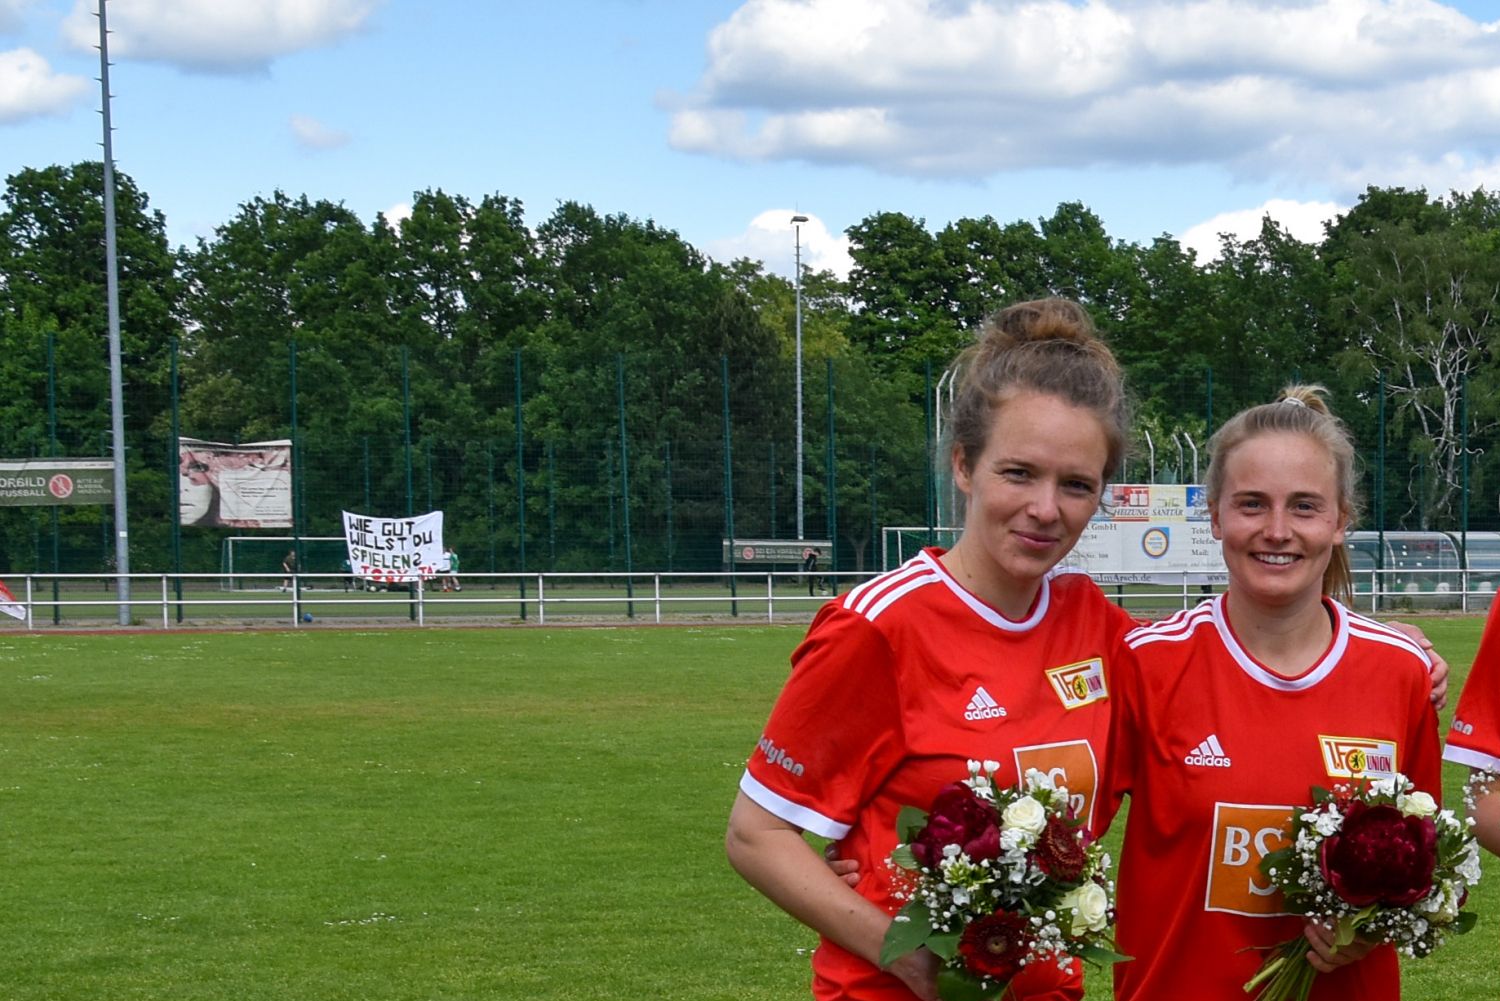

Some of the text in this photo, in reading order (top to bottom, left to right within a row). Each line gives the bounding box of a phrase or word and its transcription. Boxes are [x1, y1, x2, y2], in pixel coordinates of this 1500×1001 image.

[349, 516, 415, 536] WIE GUT
[350, 530, 432, 551] WILLST DU
[964, 706, 1007, 721] adidas
[1184, 754, 1232, 768] adidas
[1366, 754, 1392, 772] UNION
[1221, 826, 1285, 896] BS
